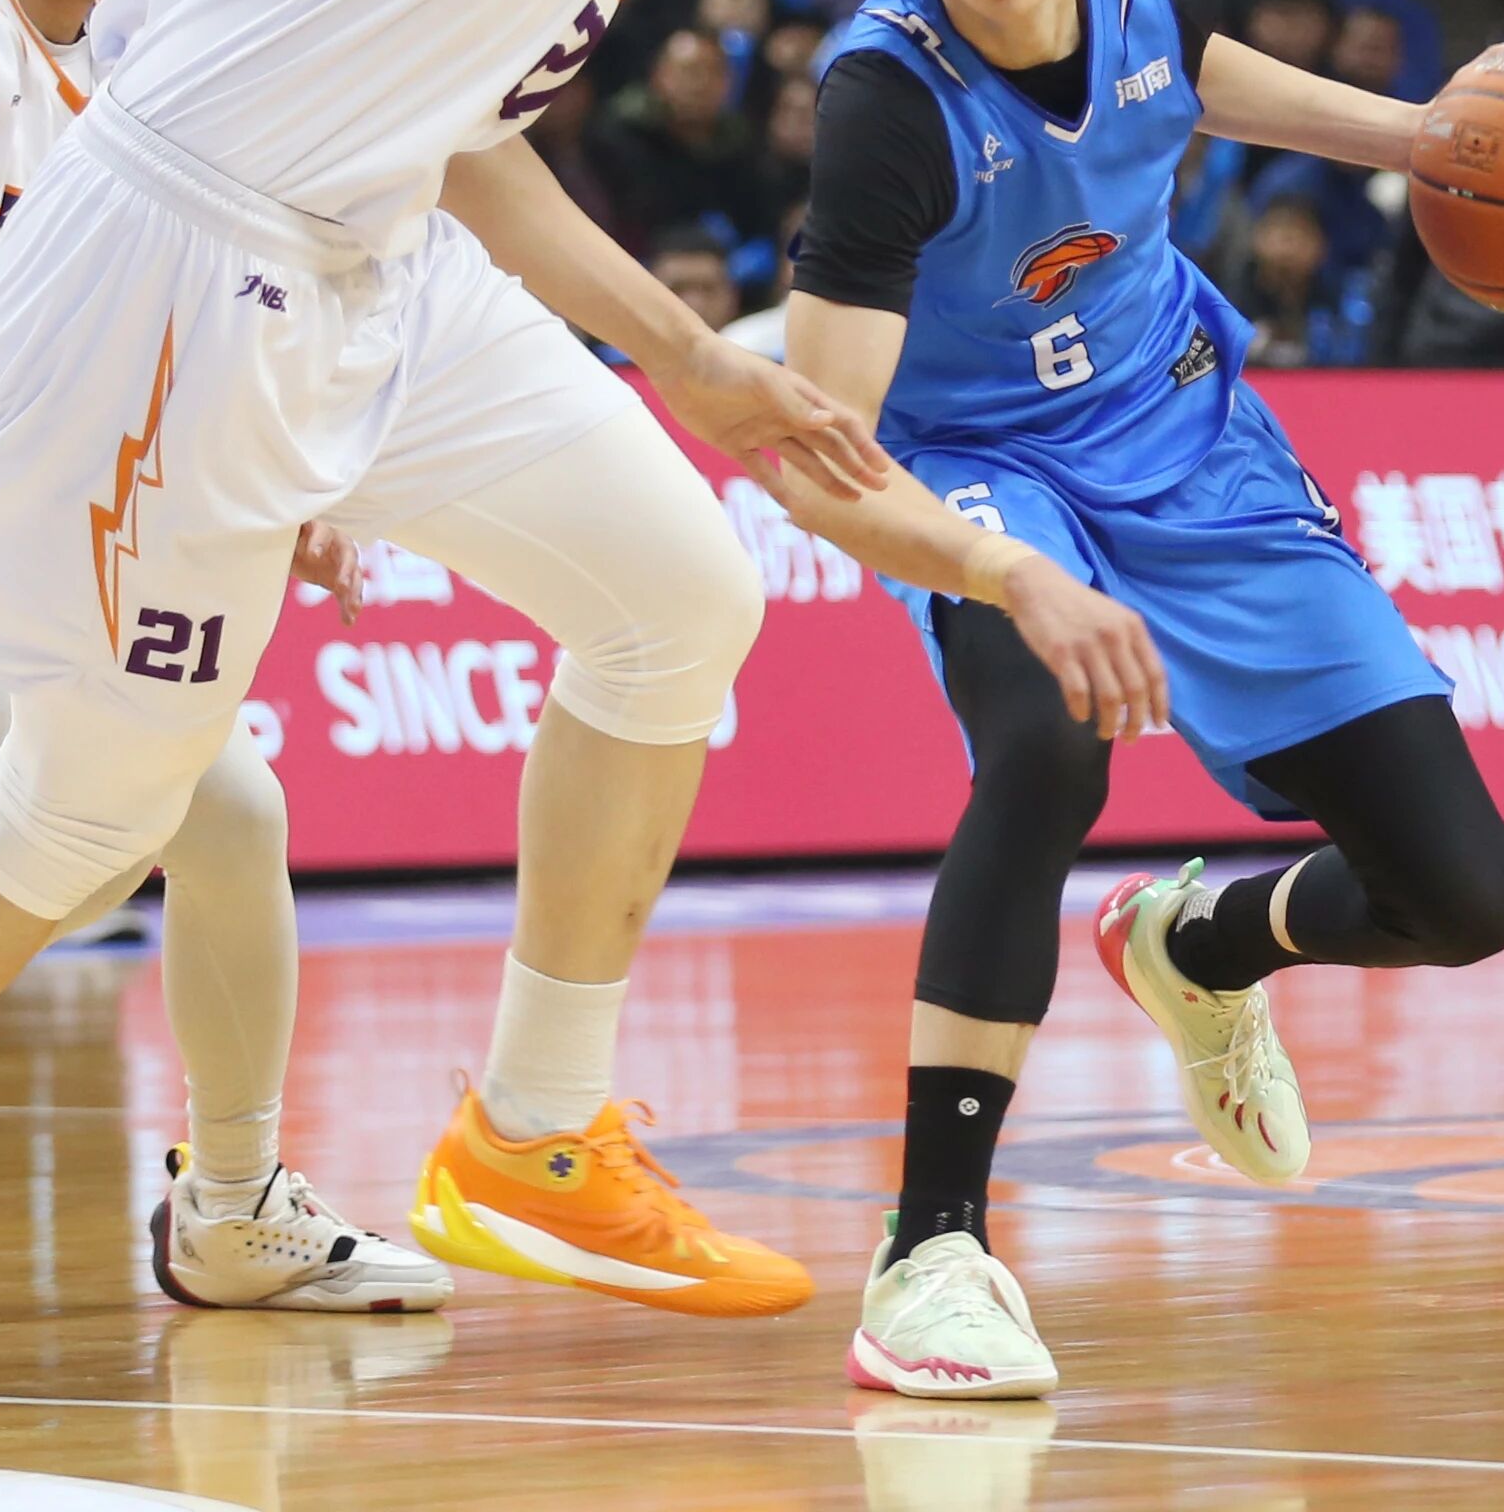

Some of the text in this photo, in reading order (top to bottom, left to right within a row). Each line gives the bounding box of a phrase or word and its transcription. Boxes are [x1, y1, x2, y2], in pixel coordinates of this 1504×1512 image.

[1115, 54, 1173, 110] 河南
[1029, 311, 1098, 392] 6
[124, 606, 226, 685] 21
[315, 637, 542, 757] SINCE
